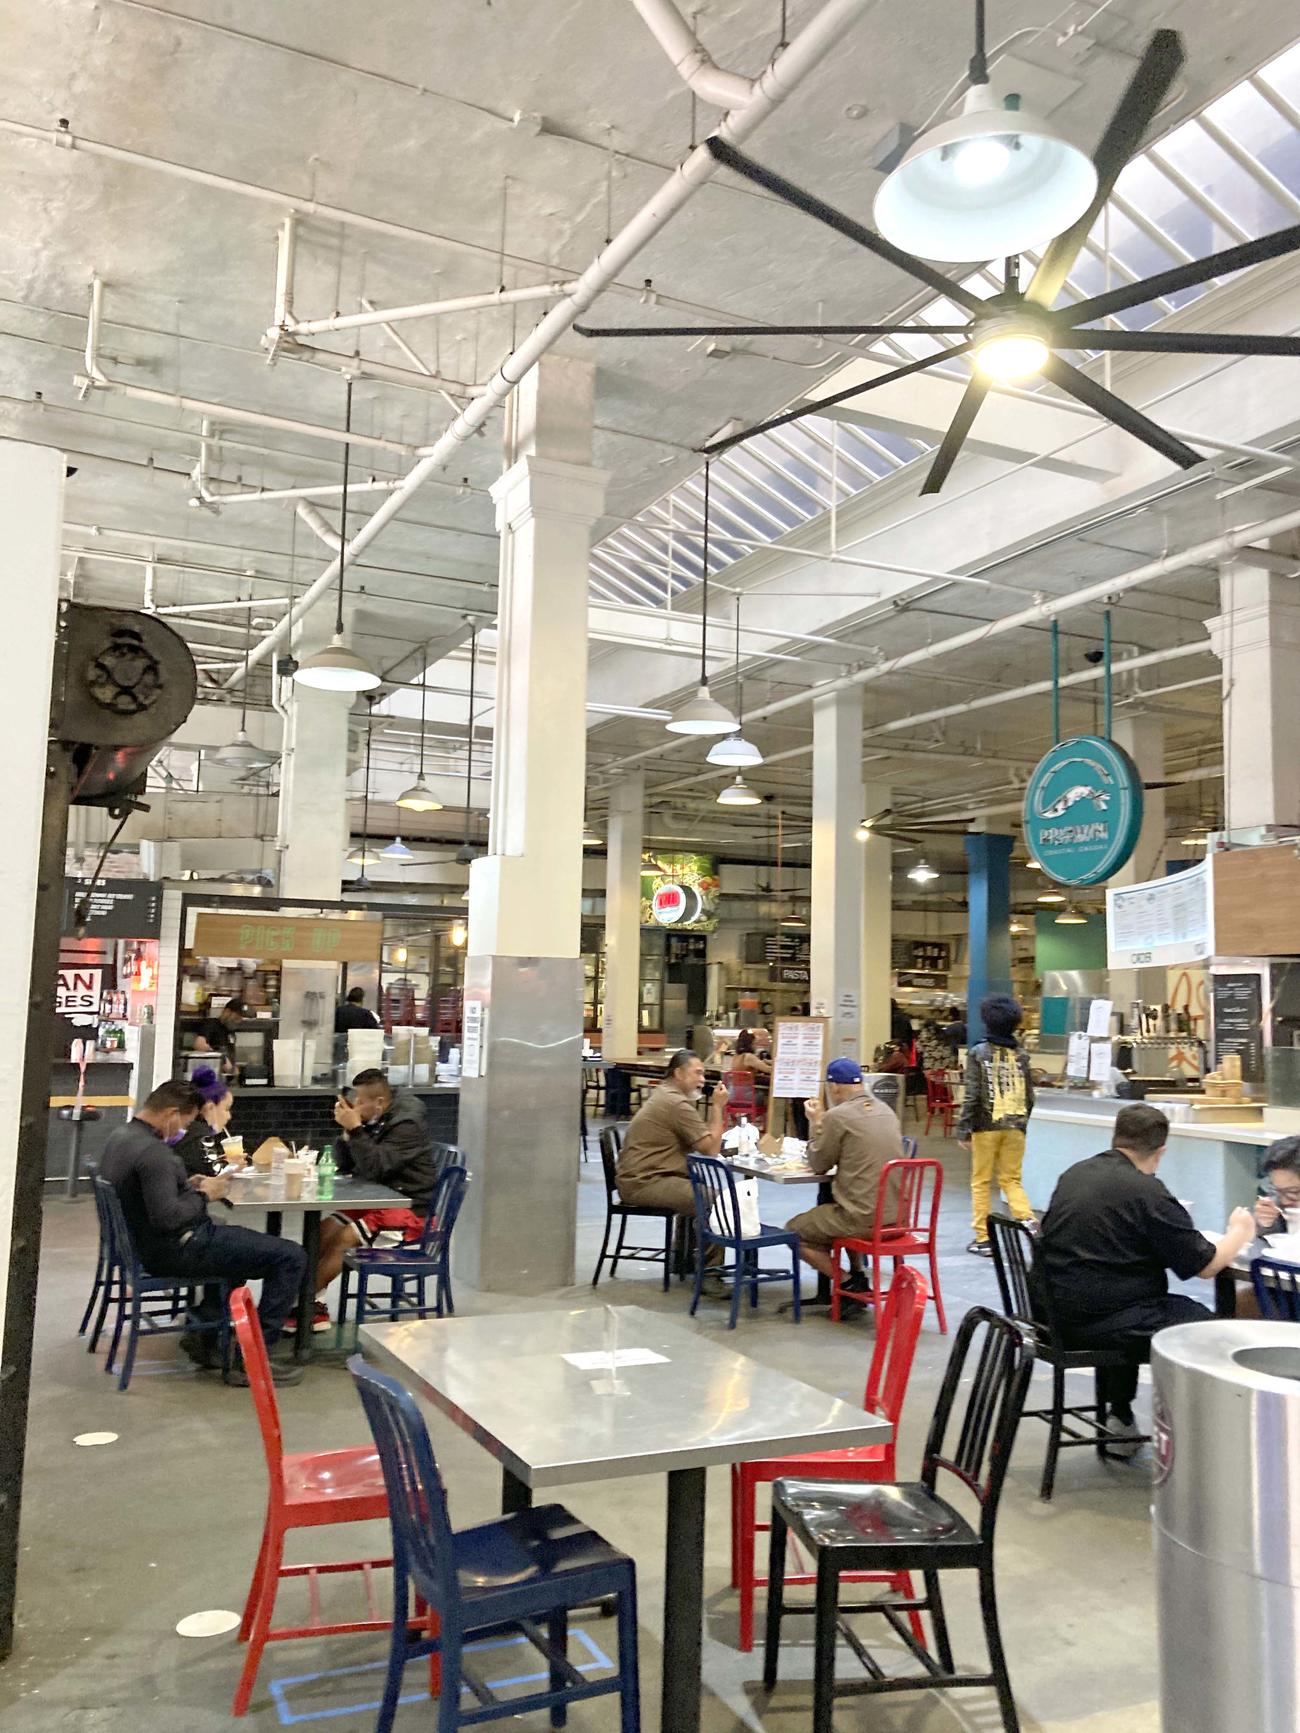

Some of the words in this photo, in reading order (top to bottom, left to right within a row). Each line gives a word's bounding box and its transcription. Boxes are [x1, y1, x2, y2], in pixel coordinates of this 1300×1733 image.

[240, 924, 296, 952] PICK
[312, 927, 340, 953] UP
[783, 968, 809, 981] PASTA
